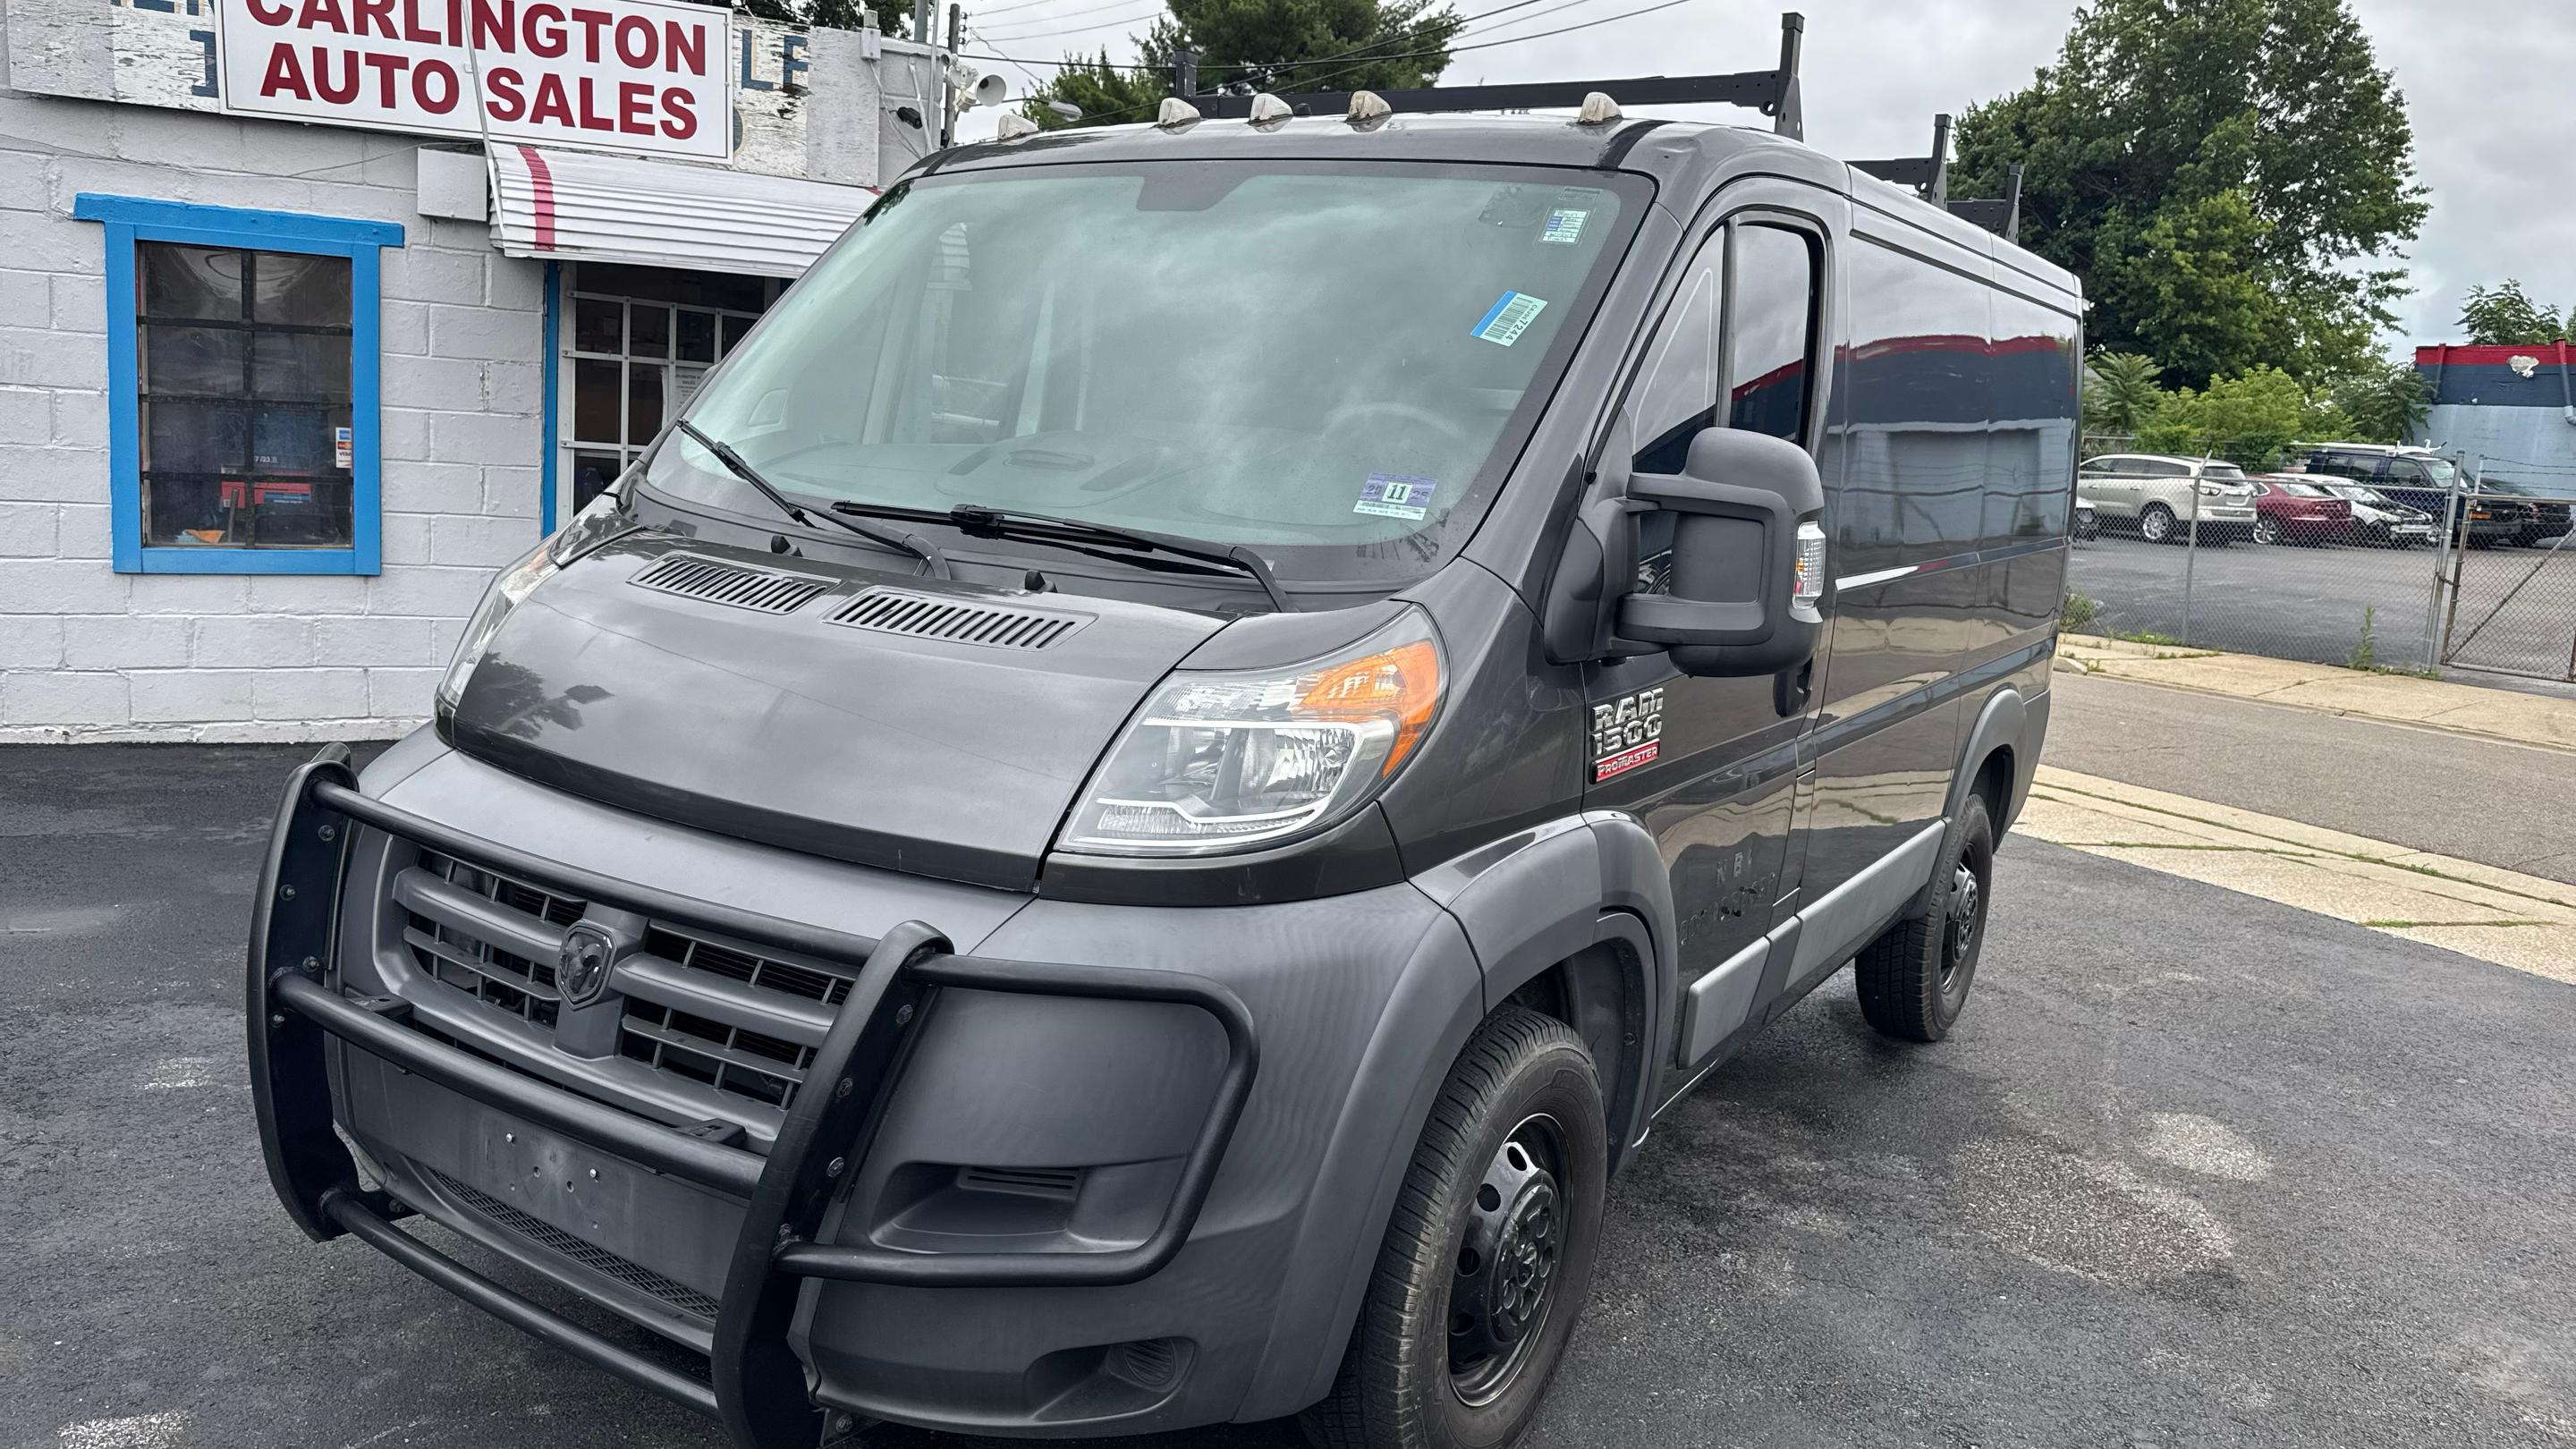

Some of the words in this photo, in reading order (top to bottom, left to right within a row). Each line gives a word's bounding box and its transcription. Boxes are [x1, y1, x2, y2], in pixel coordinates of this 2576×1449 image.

[260, 42, 460, 114] AUTO
[486, 67, 698, 140] SALES
[1387, 484, 1407, 501] 11
[1591, 687, 1664, 732] RAM
[1591, 713, 1663, 757] 1500
[1597, 745, 1659, 777] PROMASTER
